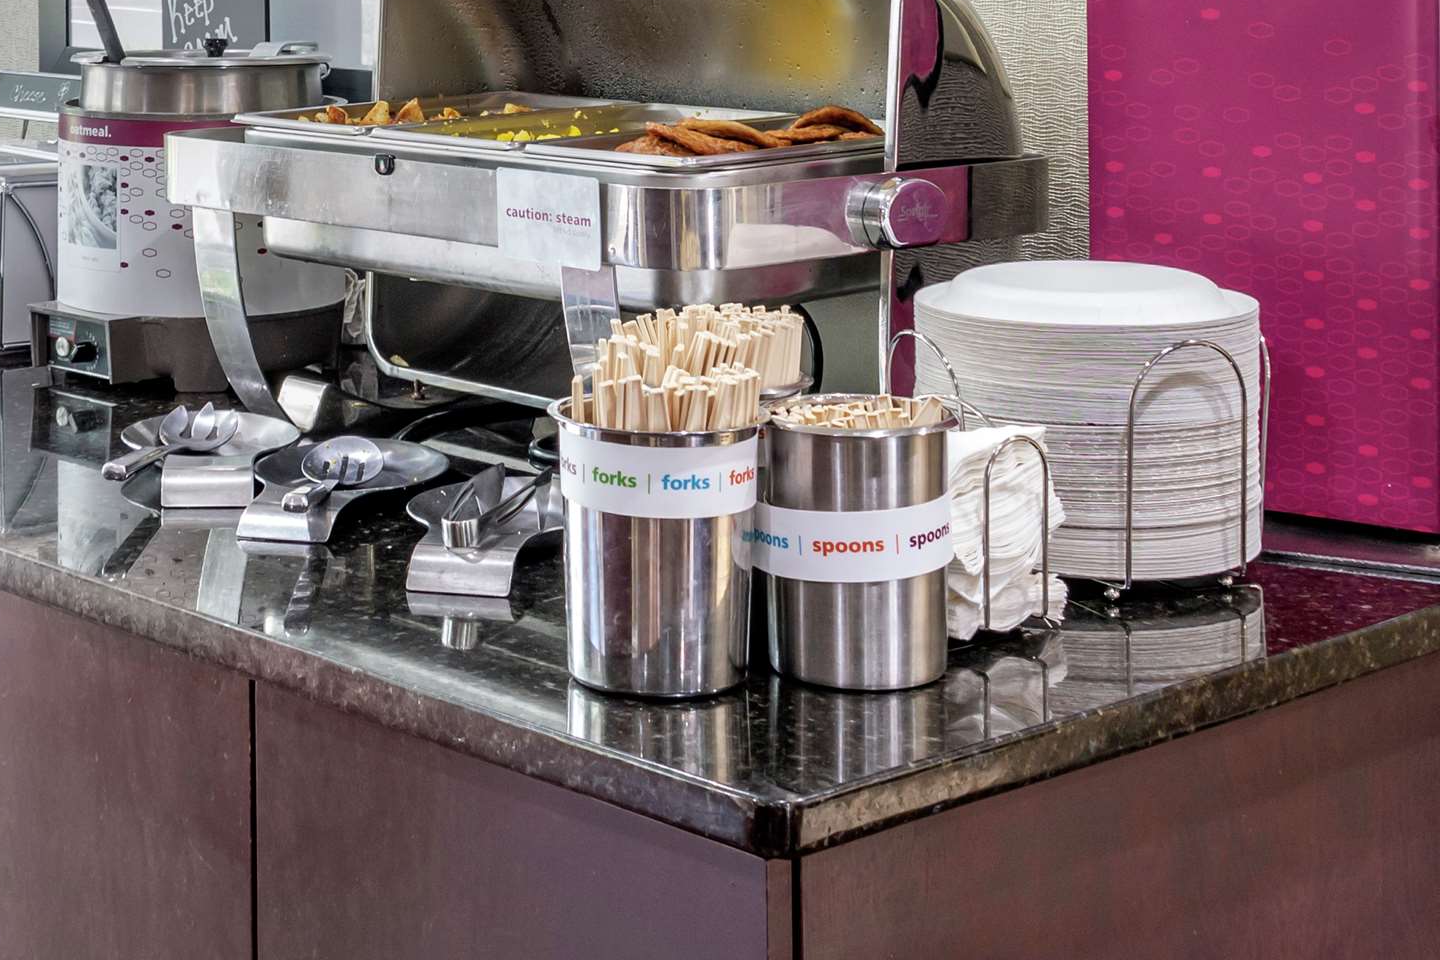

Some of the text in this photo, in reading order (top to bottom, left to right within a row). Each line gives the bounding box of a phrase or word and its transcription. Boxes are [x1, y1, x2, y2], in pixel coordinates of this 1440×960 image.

[70, 125, 112, 138] oatmeal.
[506, 207, 592, 227] caution: steam
[592, 466, 637, 488] forks
[661, 473, 710, 490] forks
[753, 522, 950, 557] poons spoons spoons
